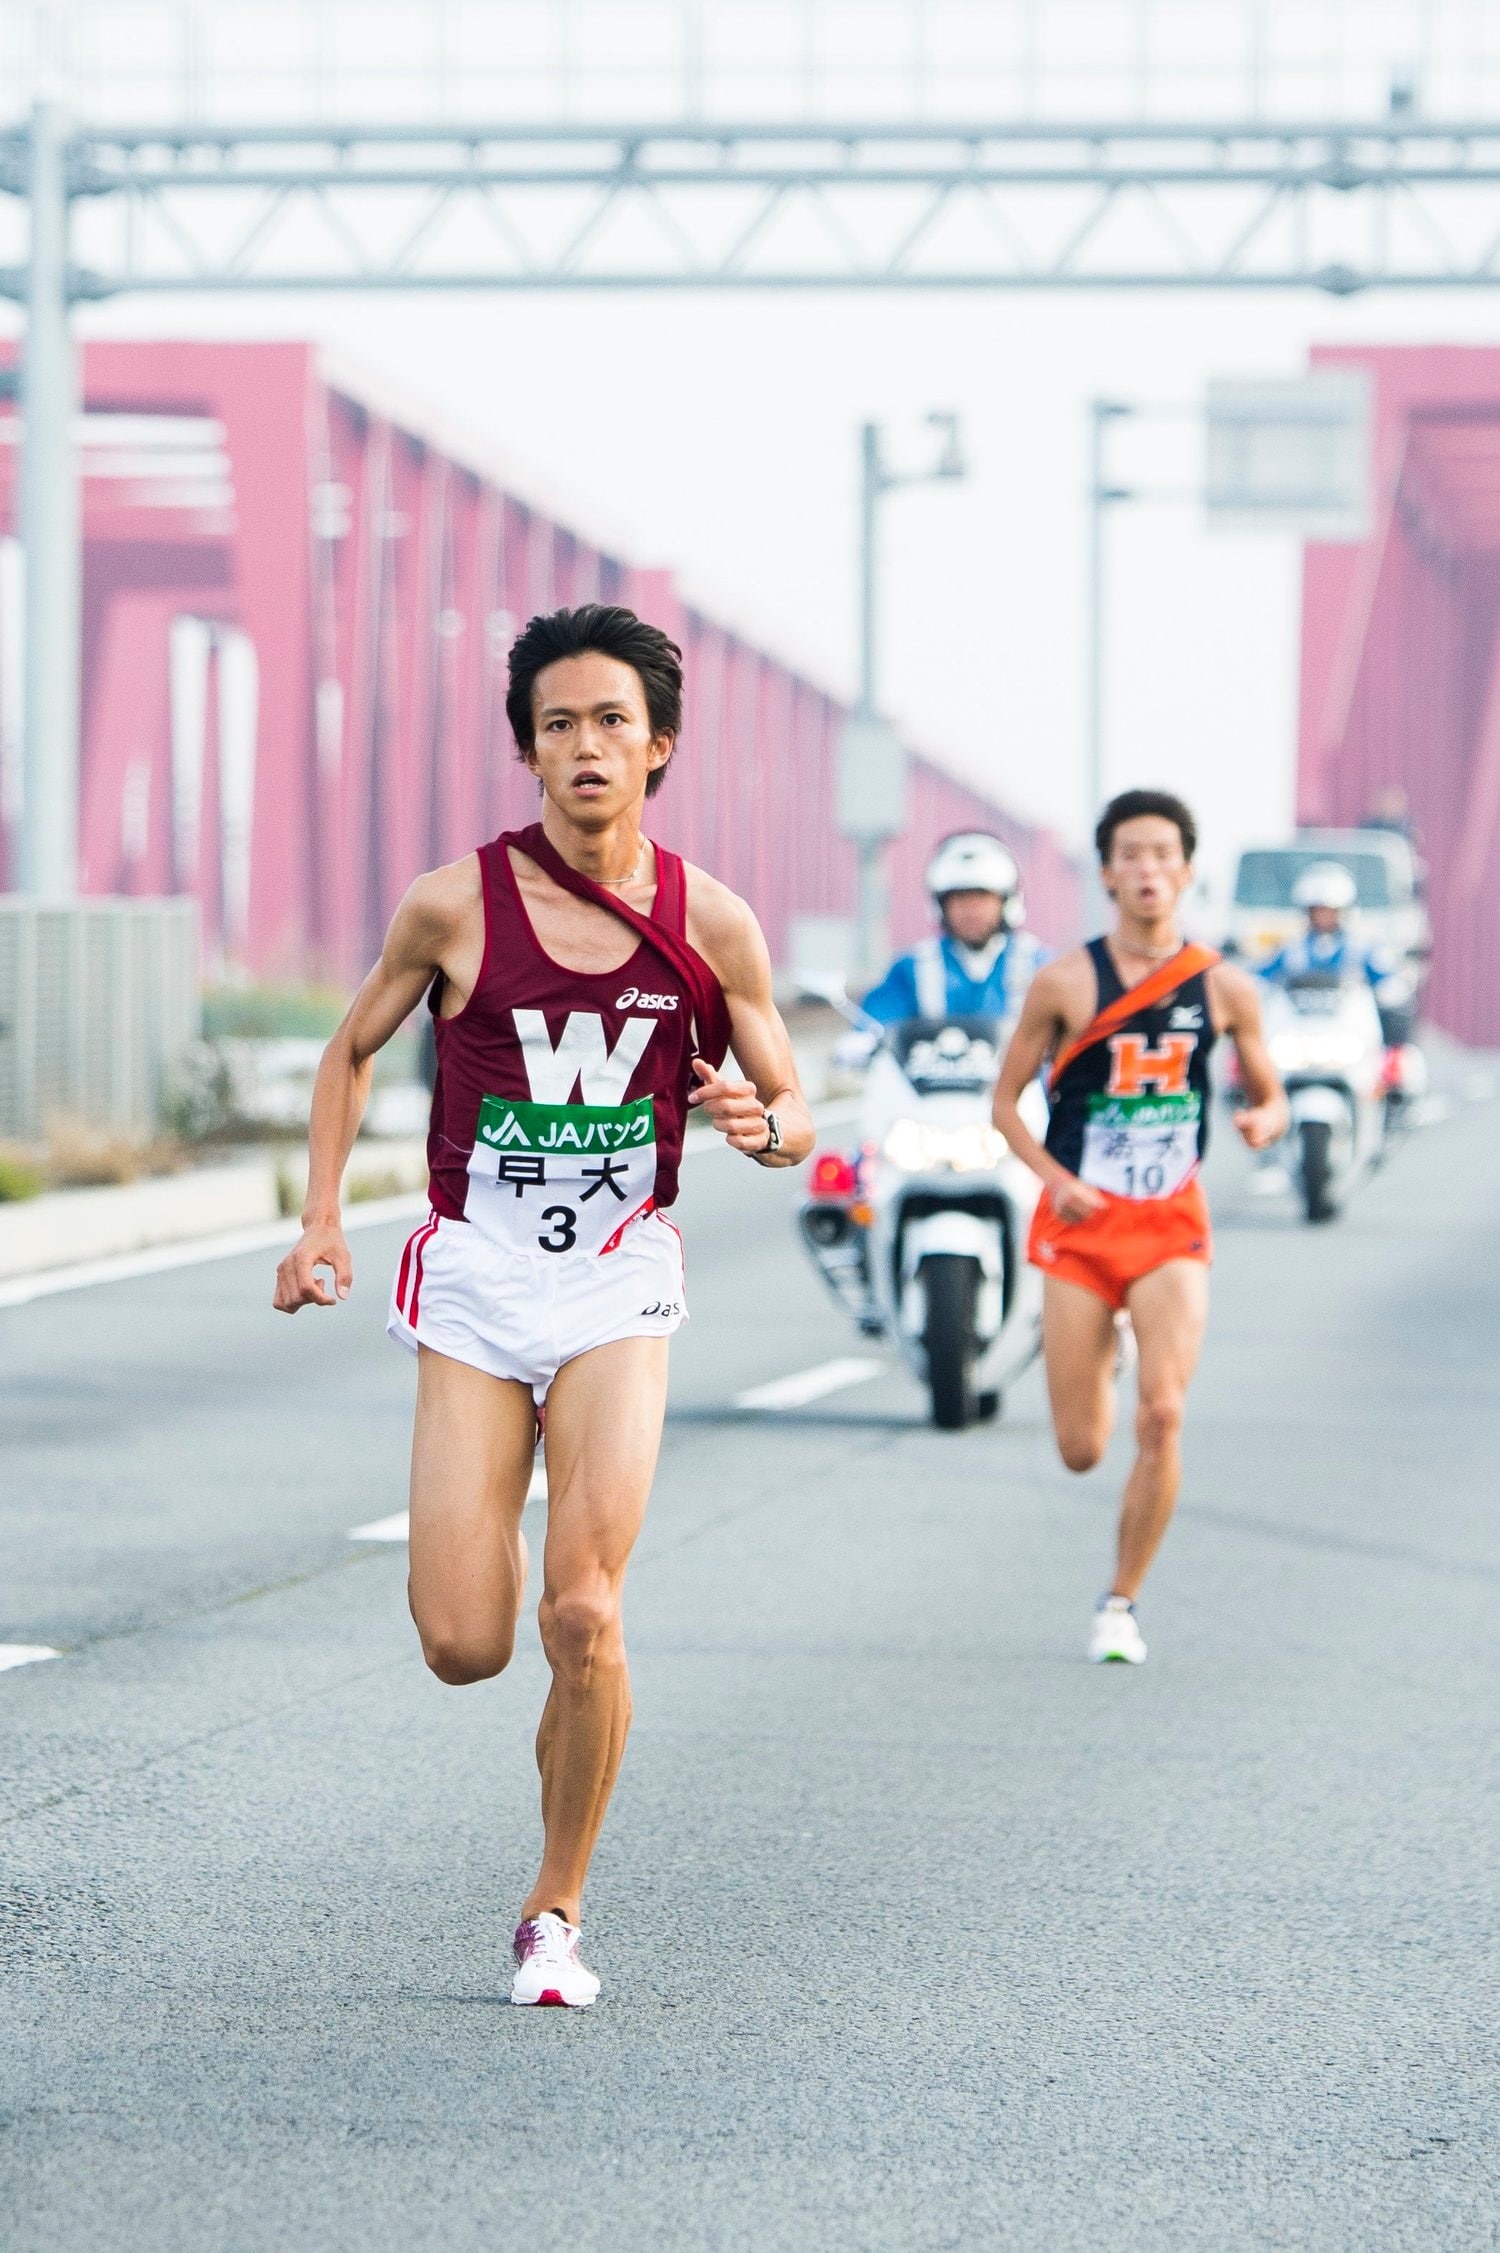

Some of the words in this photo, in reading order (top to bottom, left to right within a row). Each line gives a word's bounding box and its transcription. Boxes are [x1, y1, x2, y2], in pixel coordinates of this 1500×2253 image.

[635, 992, 680, 1011] asics
[512, 1008, 658, 1107] W
[1105, 1032, 1199, 1096] H
[538, 1114, 650, 1149] JAバンク
[1124, 1164, 1164, 1196] 10
[537, 1205, 577, 1254] 3
